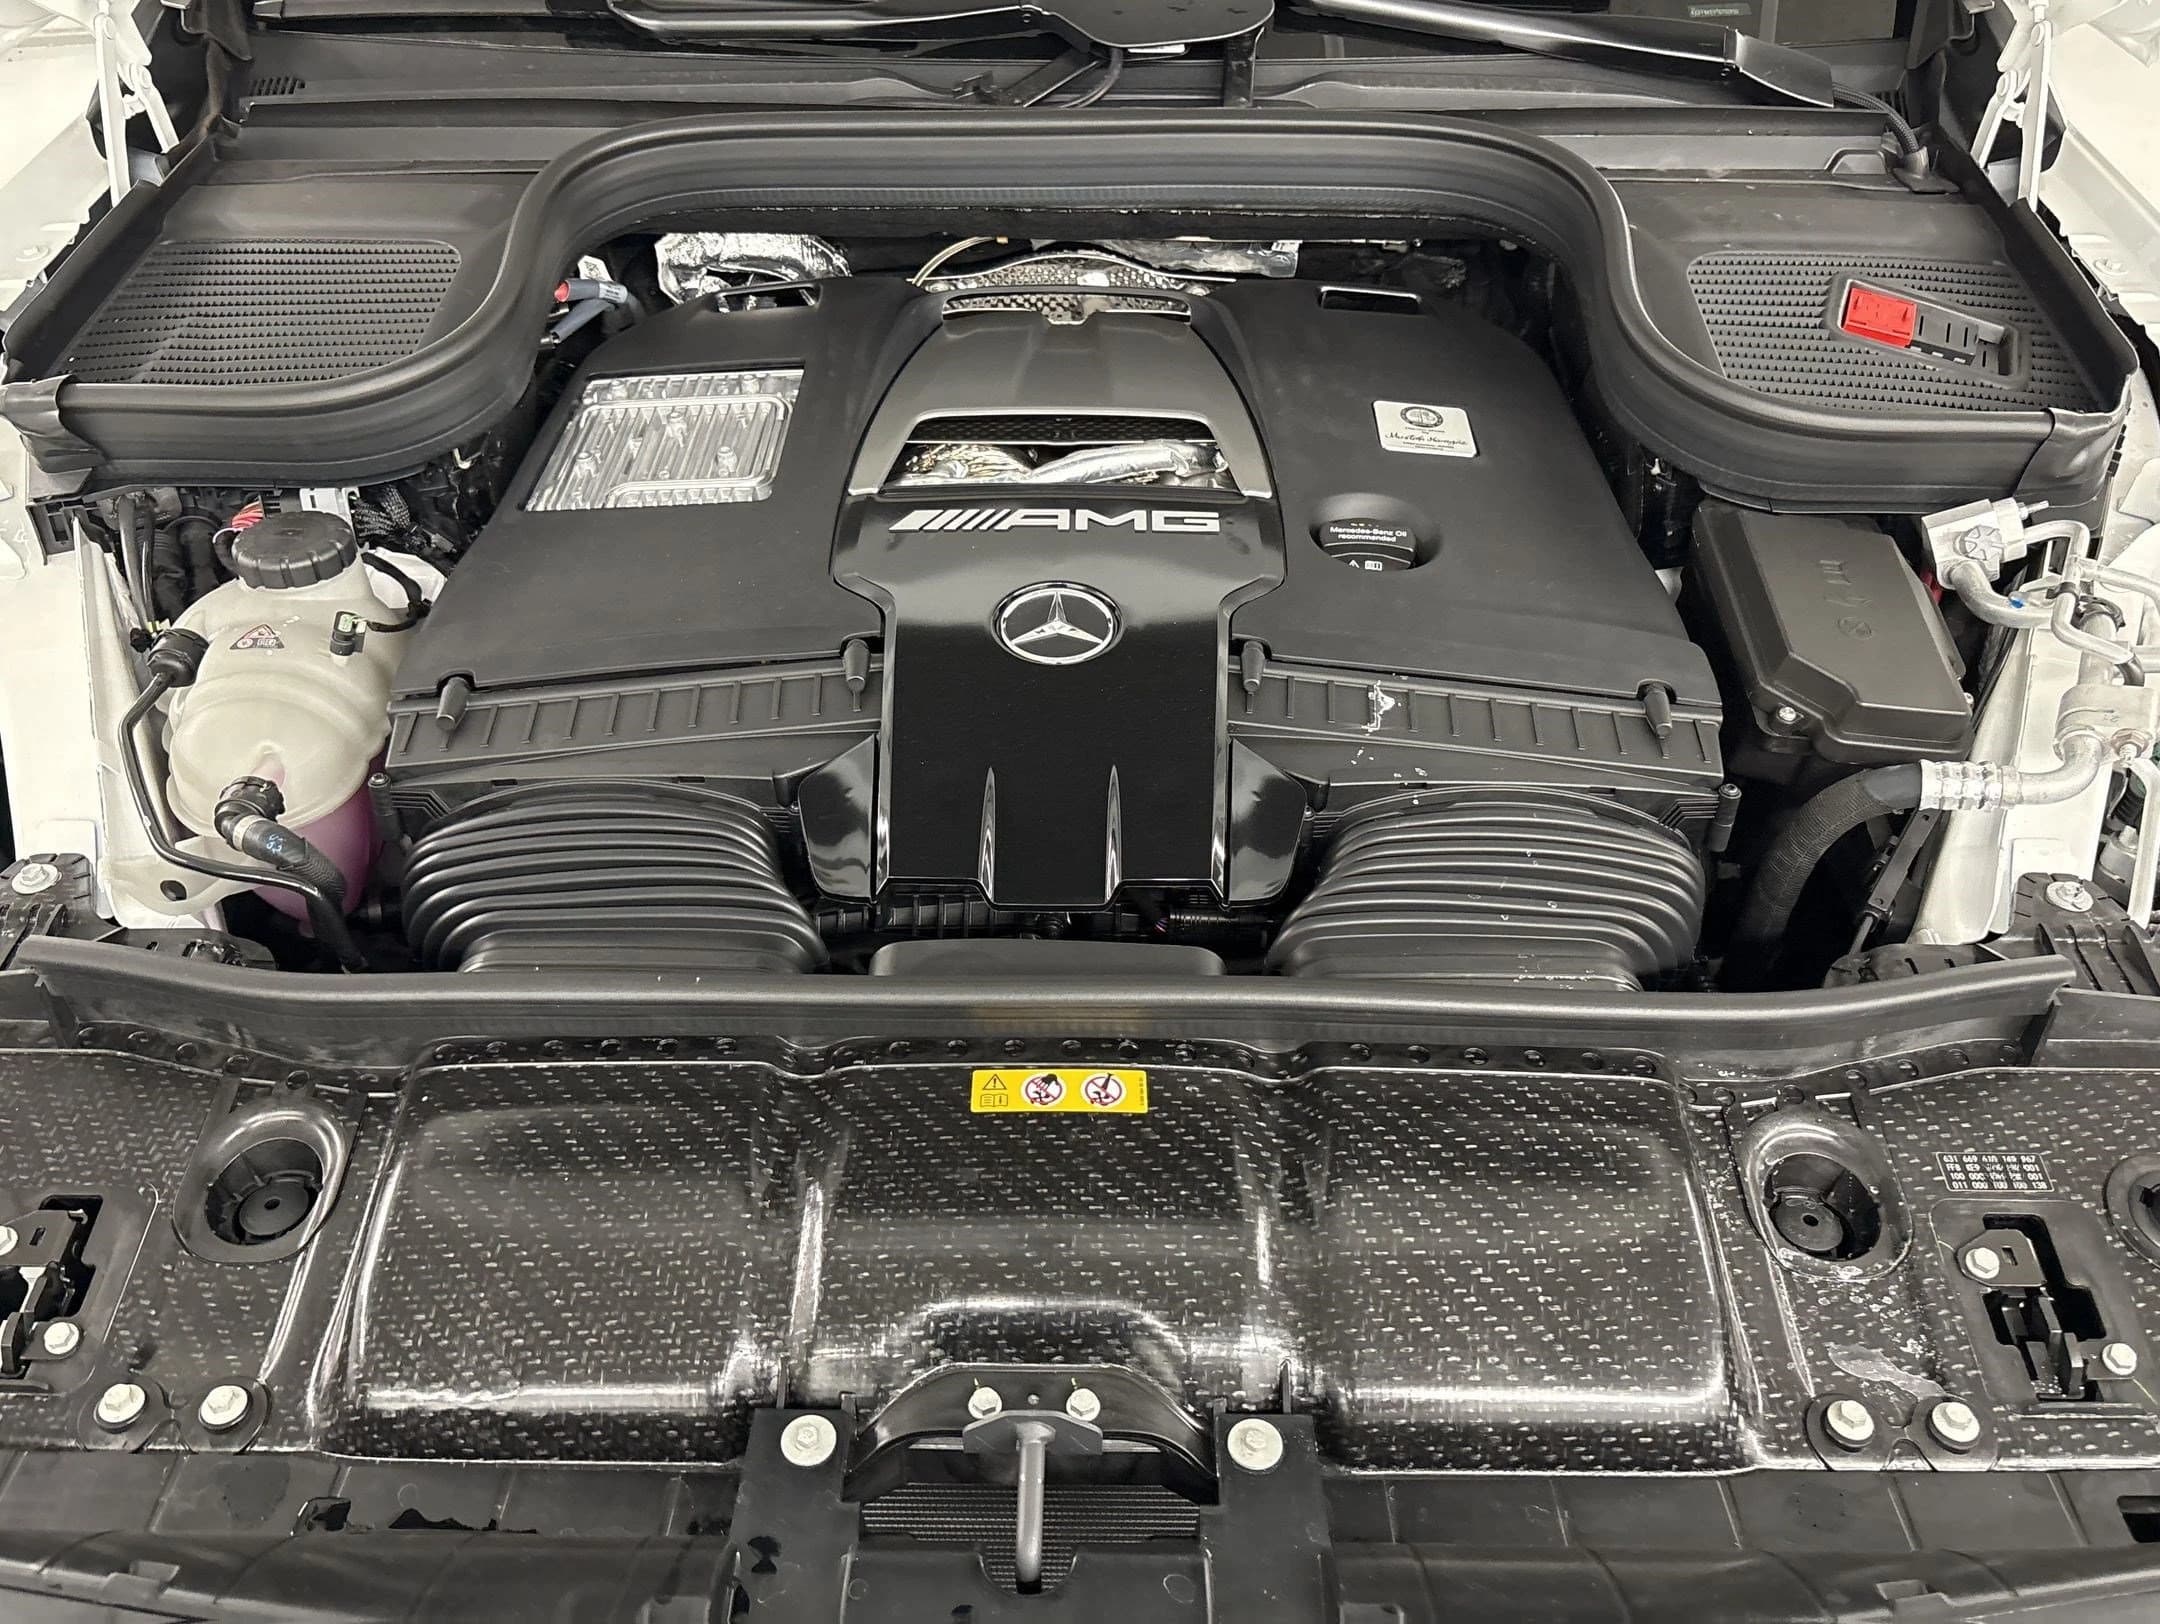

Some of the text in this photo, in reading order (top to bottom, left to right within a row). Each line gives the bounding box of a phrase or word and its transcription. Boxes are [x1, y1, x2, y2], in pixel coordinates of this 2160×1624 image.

[994, 508, 1221, 532] AMG
[1329, 526, 1394, 537] Mercedes-Benz
[1337, 533, 1397, 542] recommended
